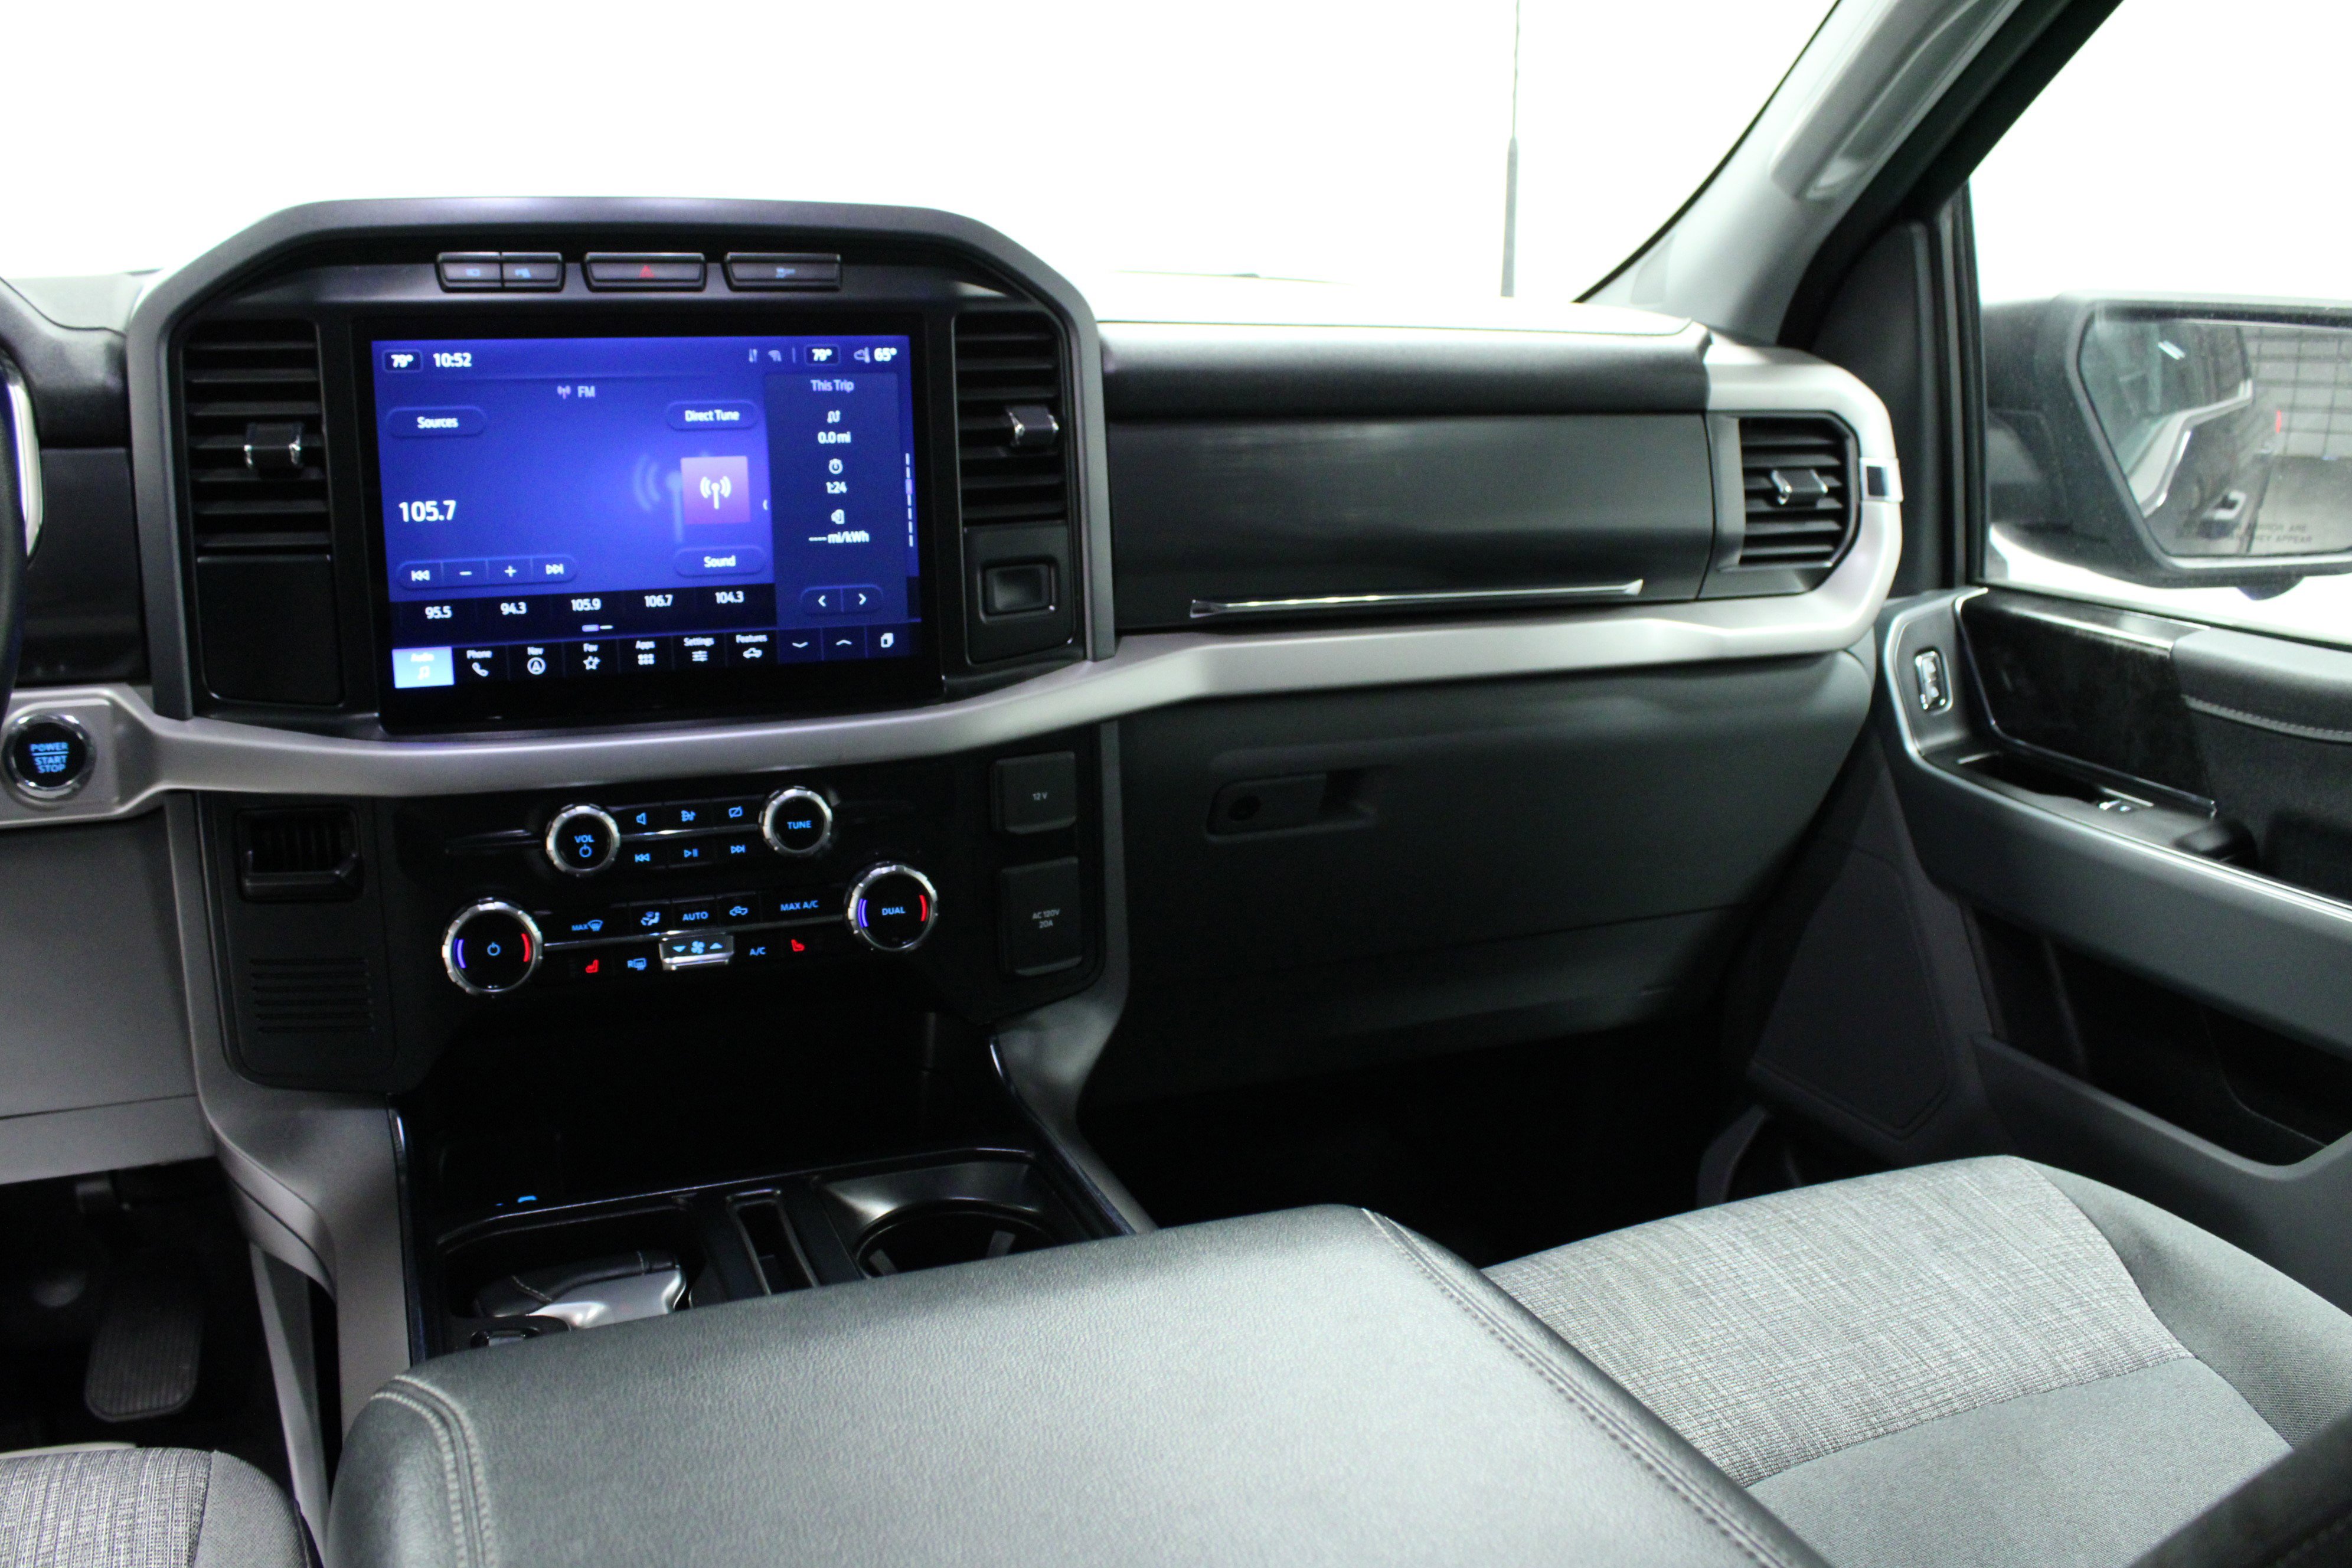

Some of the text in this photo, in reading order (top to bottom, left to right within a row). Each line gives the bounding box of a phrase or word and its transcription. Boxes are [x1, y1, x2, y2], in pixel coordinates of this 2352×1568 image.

[433, 352, 472, 368] 10:52
[578, 386, 596, 398] FM
[811, 380, 855, 393] This Trip
[685, 410, 740, 422] Direct Tune
[417, 415, 459, 430] Sources
[826, 482, 848, 494] 1:24
[398, 500, 456, 522] 105.7
[704, 556, 736, 568] Sound
[425, 591, 744, 619] 95.5 94.3 105.9 106.7 104.3
[466, 649, 492, 659] Phone
[527, 647, 544, 656] Nav
[583, 642, 599, 652] Fav
[635, 640, 655, 650] Apps
[684, 636, 714, 647] Settings
[735, 634, 768, 643] Features
[31, 742, 69, 752] POWER
[34, 755, 68, 765] START
[38, 764, 67, 773] STOP
[787, 821, 812, 829] TUNE
[574, 835, 594, 844] VOL
[780, 900, 819, 912] MAX A/C
[881, 907, 906, 916] DUAL
[682, 912, 708, 922] AUTO
[749, 947, 766, 956] A/C
